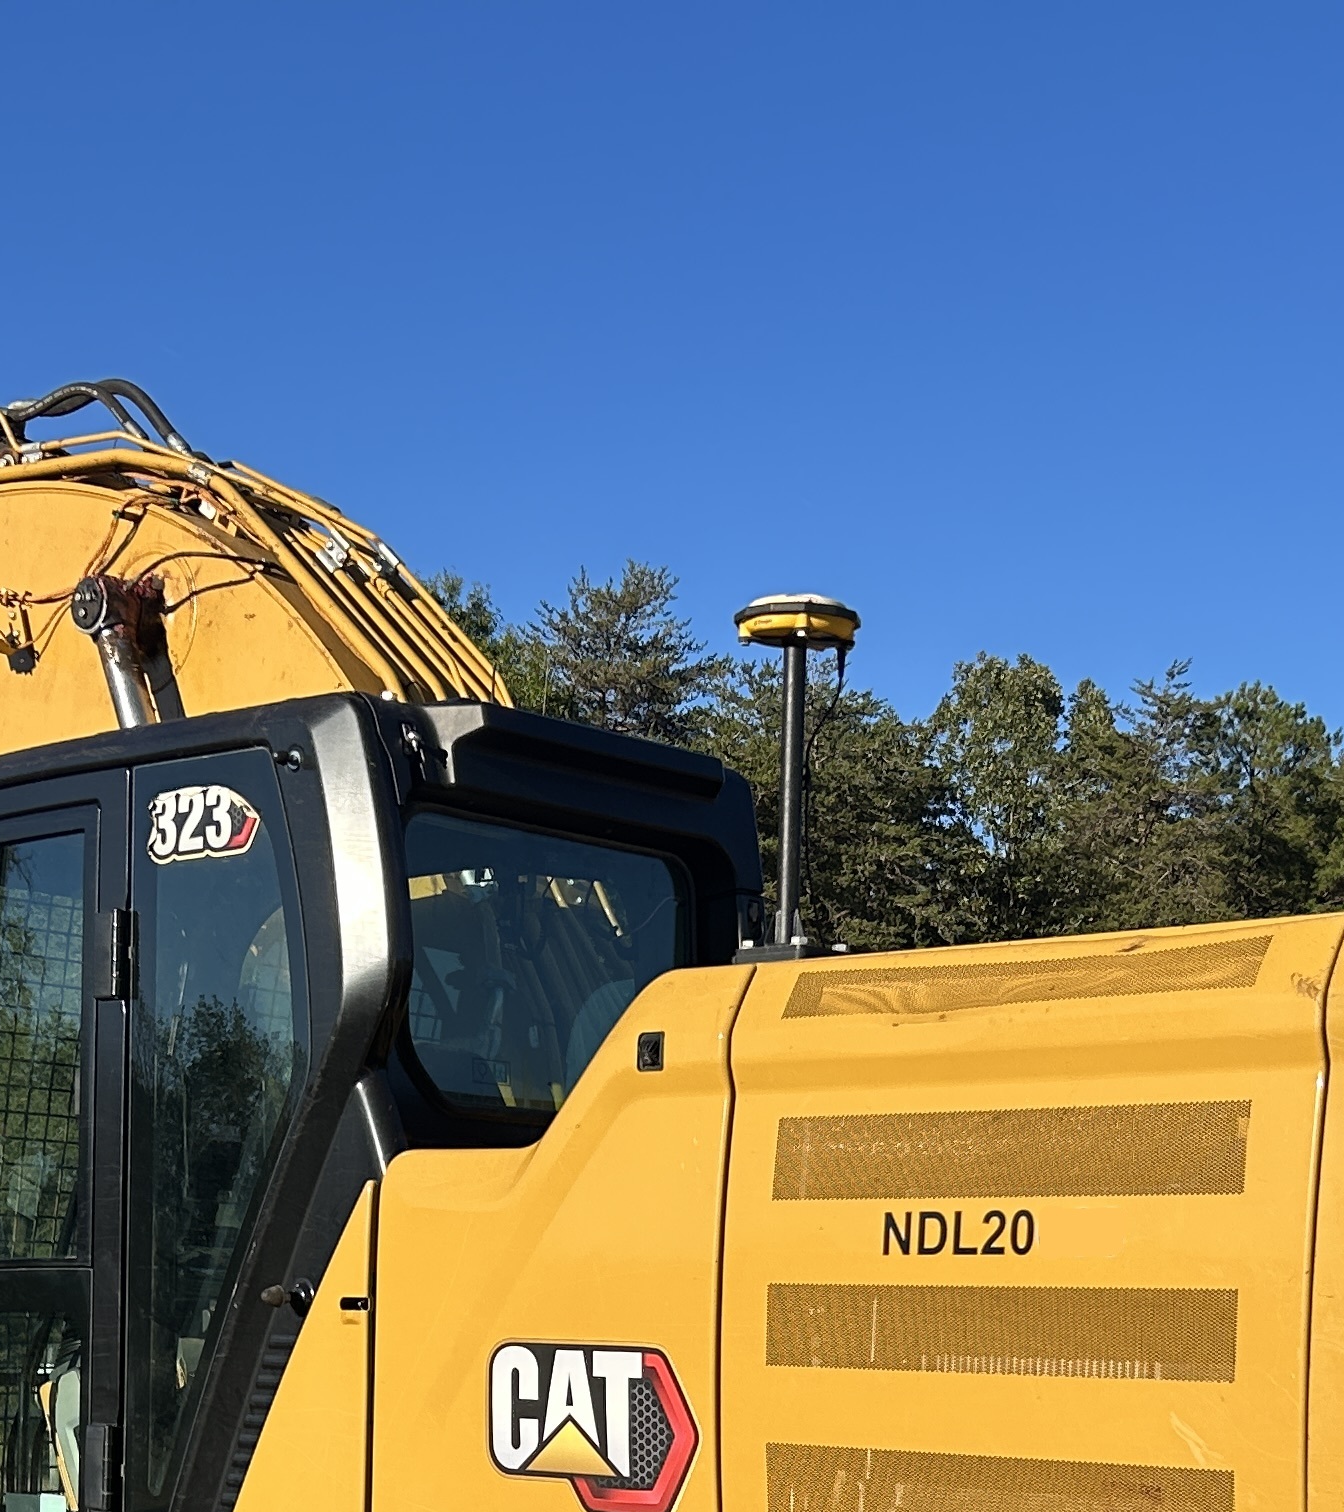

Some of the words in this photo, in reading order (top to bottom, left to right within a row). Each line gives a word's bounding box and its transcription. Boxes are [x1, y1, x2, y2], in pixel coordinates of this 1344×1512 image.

[152, 785, 232, 856] 323
[882, 1209, 1035, 1256] NDL20
[491, 1345, 643, 1478] CAT
